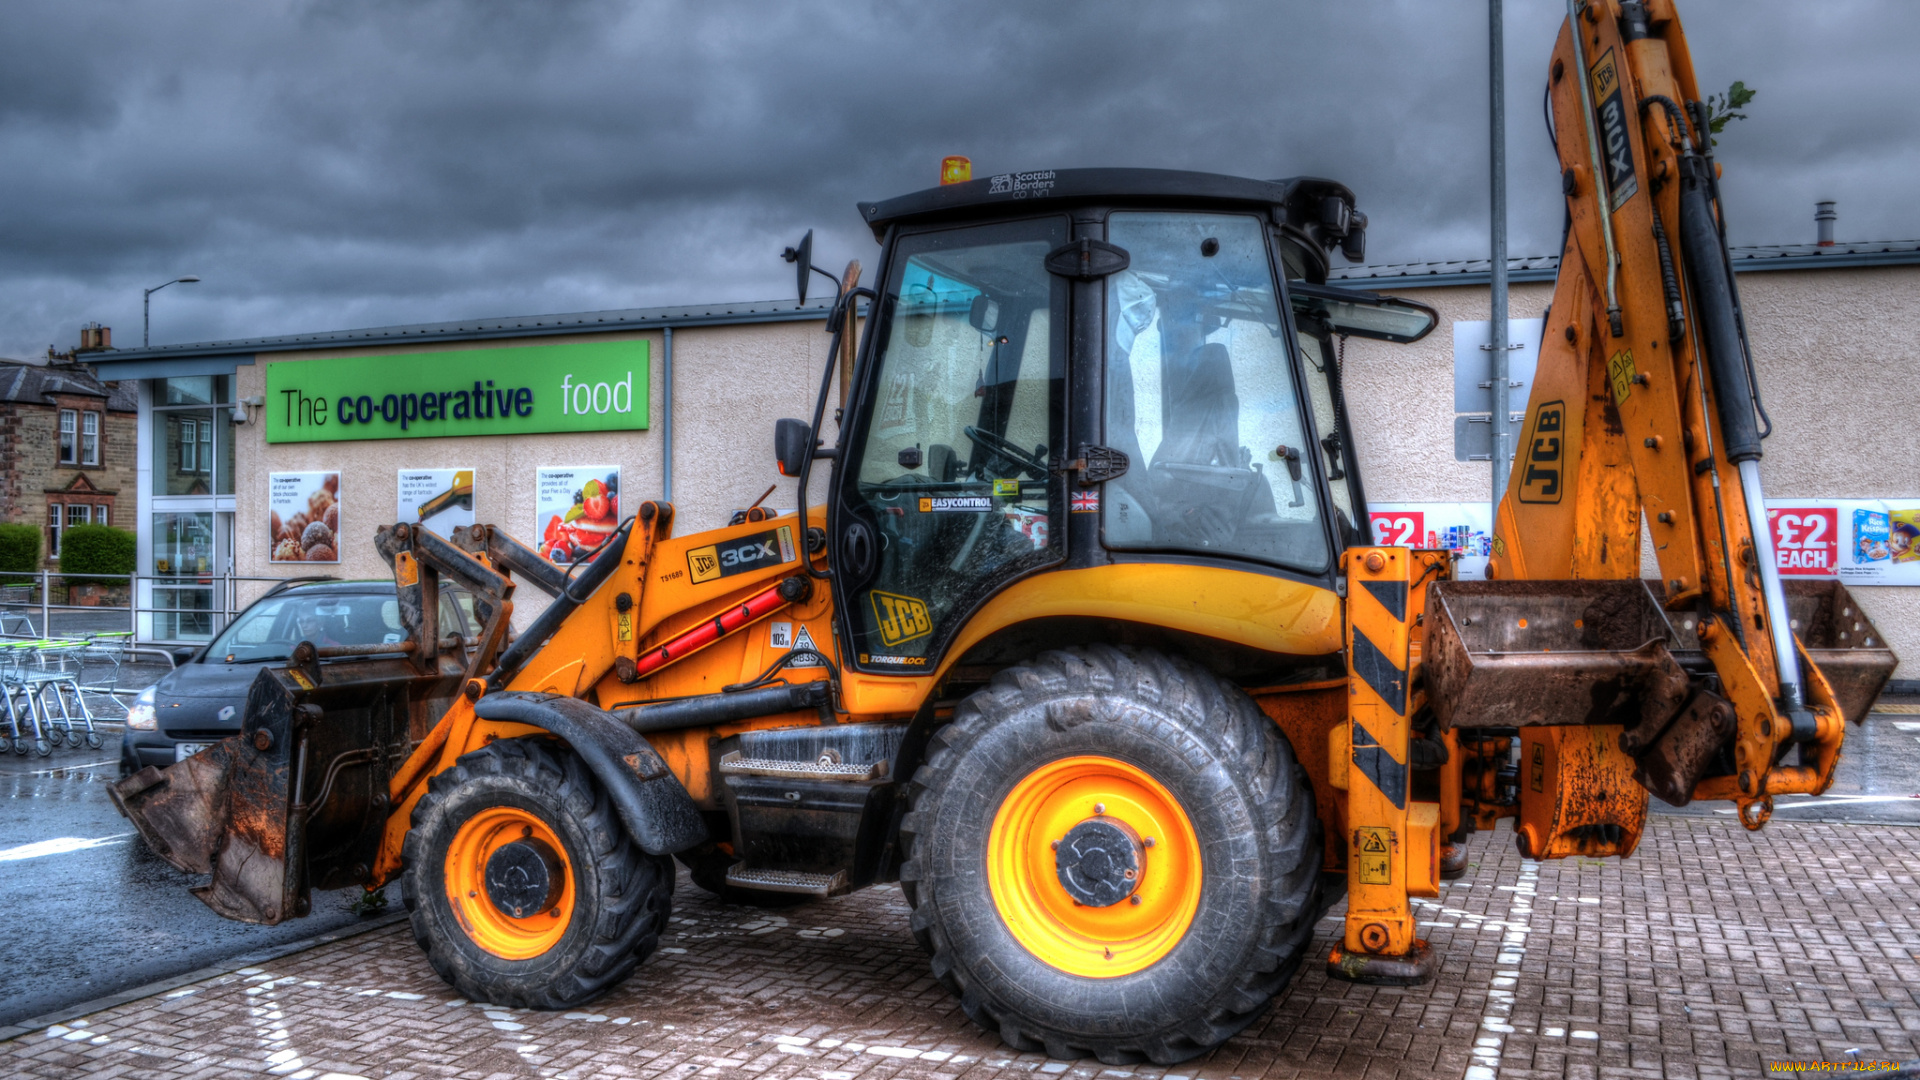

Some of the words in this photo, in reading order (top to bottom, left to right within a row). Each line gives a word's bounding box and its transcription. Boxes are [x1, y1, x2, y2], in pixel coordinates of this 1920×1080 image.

[1597, 64, 1614, 92] JCB
[1603, 100, 1630, 182] 3CX
[1014, 180, 1054, 190] Borders
[1015, 170, 1056, 181] Scottish
[280, 389, 328, 427] The
[337, 380, 534, 430] co-operative
[560, 371, 632, 415] food
[1524, 409, 1561, 495] JCB
[931, 497, 993, 510] EASYCONTROL
[1371, 517, 1415, 549] £2
[1776, 514, 1828, 549] £2
[695, 554, 715, 573] JCB
[721, 539, 776, 567] 3CX
[1776, 550, 1827, 568] EACH
[880, 596, 928, 641] JCB
[772, 633, 785, 646] 103
[870, 655, 927, 665] TORQUELOCK
